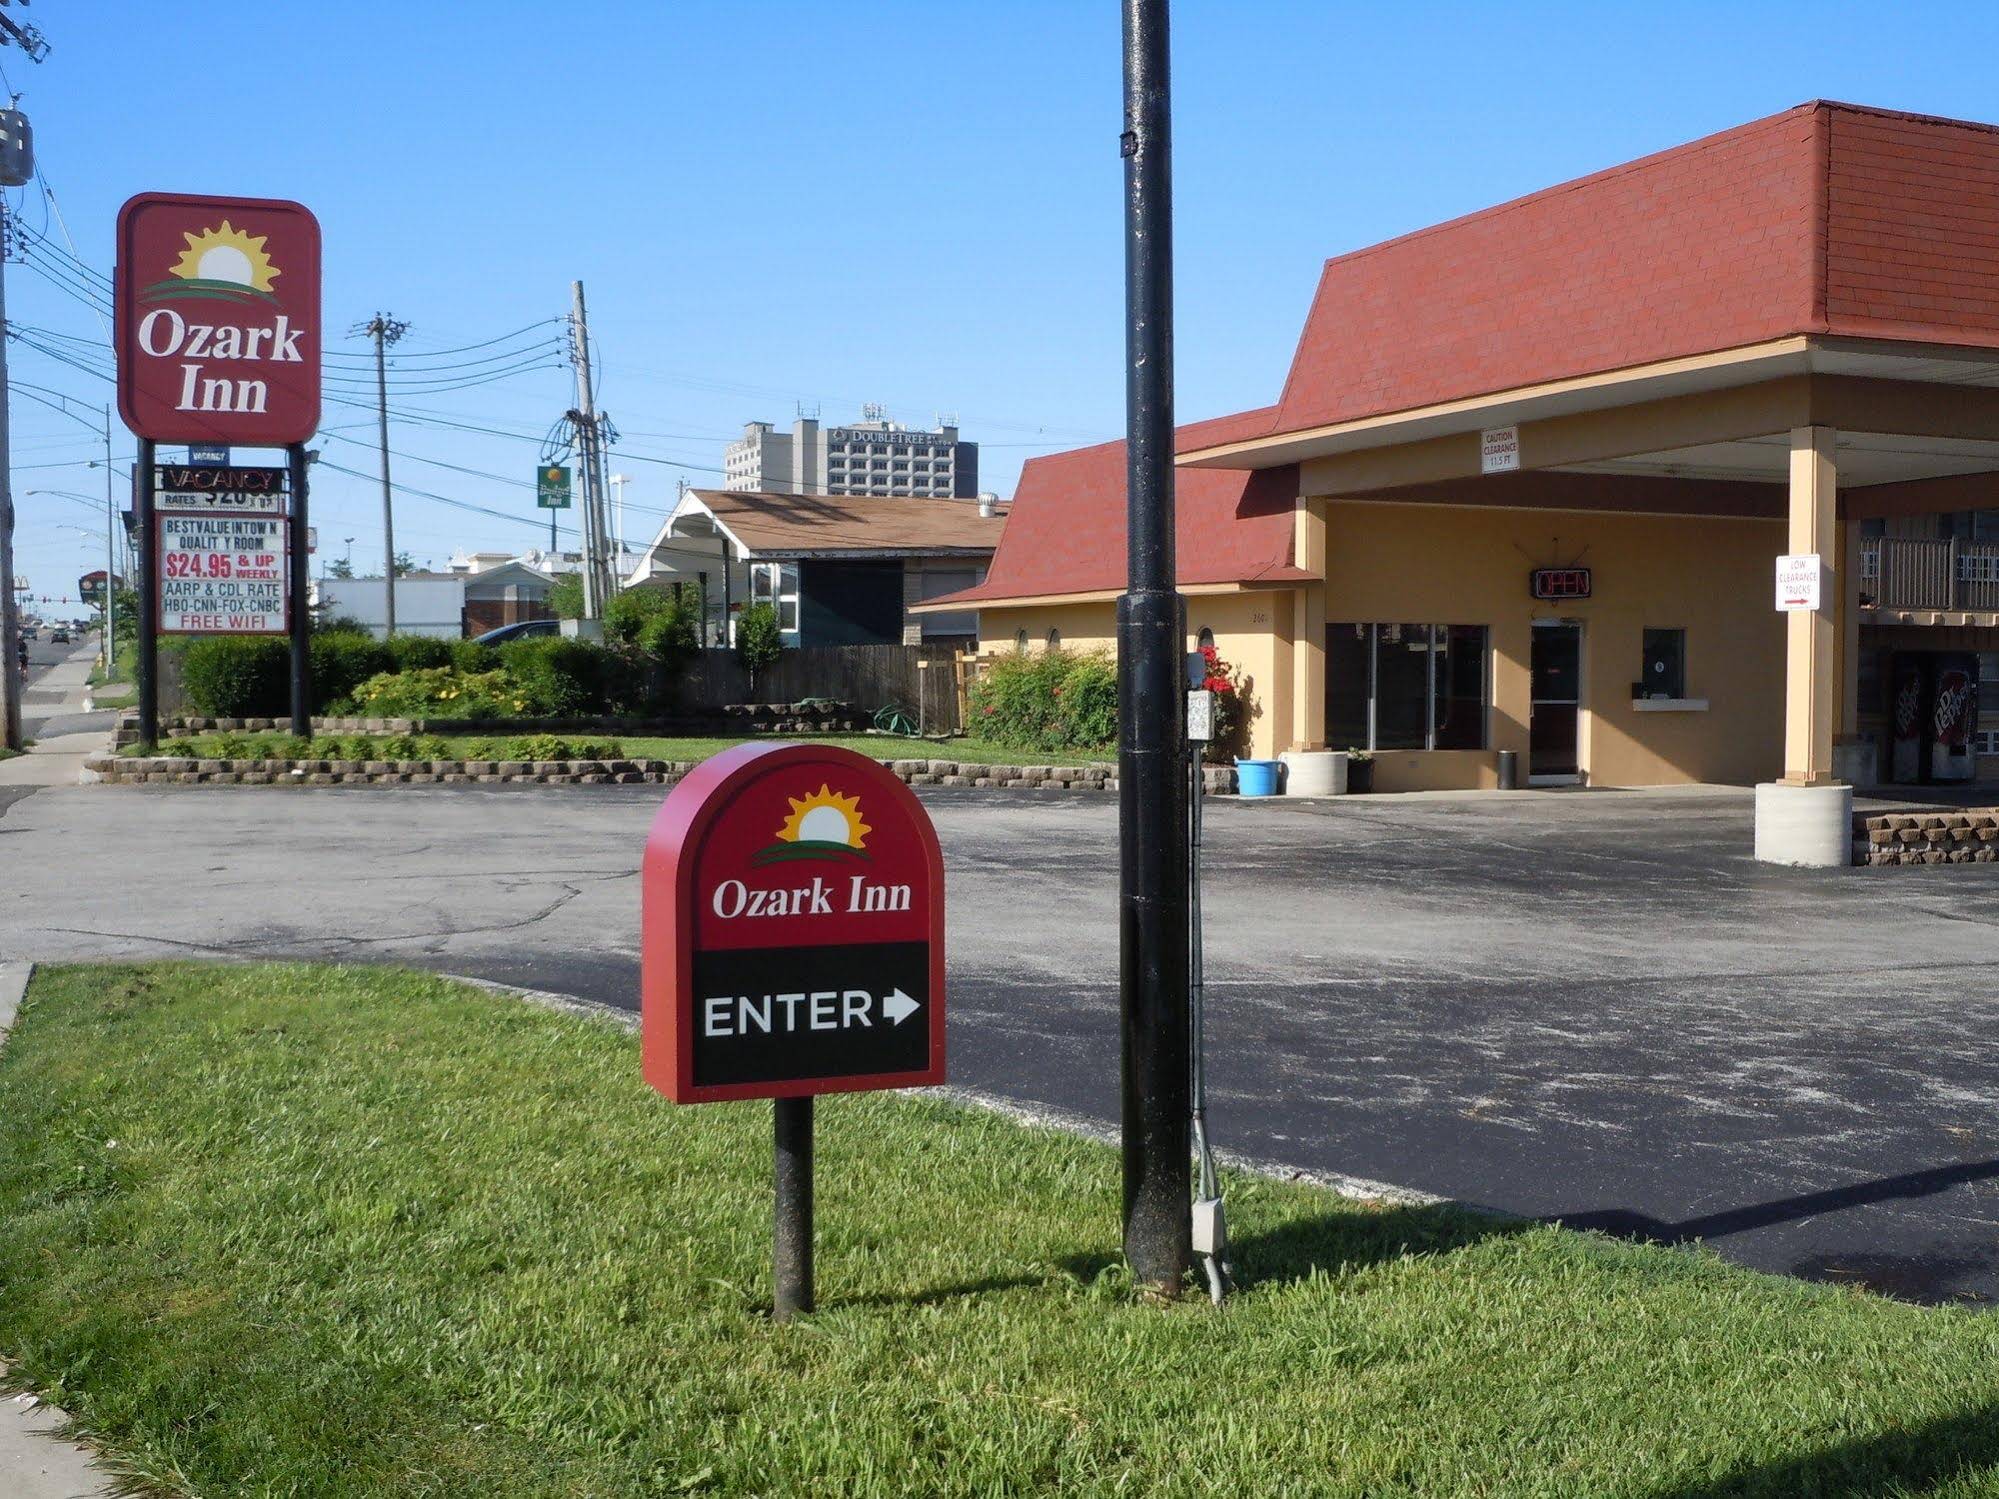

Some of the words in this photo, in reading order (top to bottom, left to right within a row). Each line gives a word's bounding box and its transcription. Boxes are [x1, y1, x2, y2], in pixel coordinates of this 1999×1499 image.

[139, 309, 305, 361] Ozark
[175, 364, 267, 413] Inn
[1486, 431, 1513, 444] CAUTION
[169, 469, 273, 490] VACANCY
[165, 494, 196, 505] RATES
[166, 552, 231, 579] $24.95
[238, 555, 249, 566] &
[255, 555, 275, 566] UP
[236, 569, 278, 579] WEEKLY
[1791, 560, 1807, 570] LOW
[1539, 572, 1589, 595] OPEN
[1779, 571, 1817, 583] CLEARANCE
[166, 582, 200, 596] AARP
[205, 583, 214, 596] &
[218, 583, 243, 597] CDL
[248, 583, 280, 597] RATE
[181, 615, 222, 629] FREE
[229, 615, 266, 629] WIFI
[712, 877, 834, 919] Ozark
[846, 875, 912, 914] Inn
[704, 989, 874, 1037] ENTER
